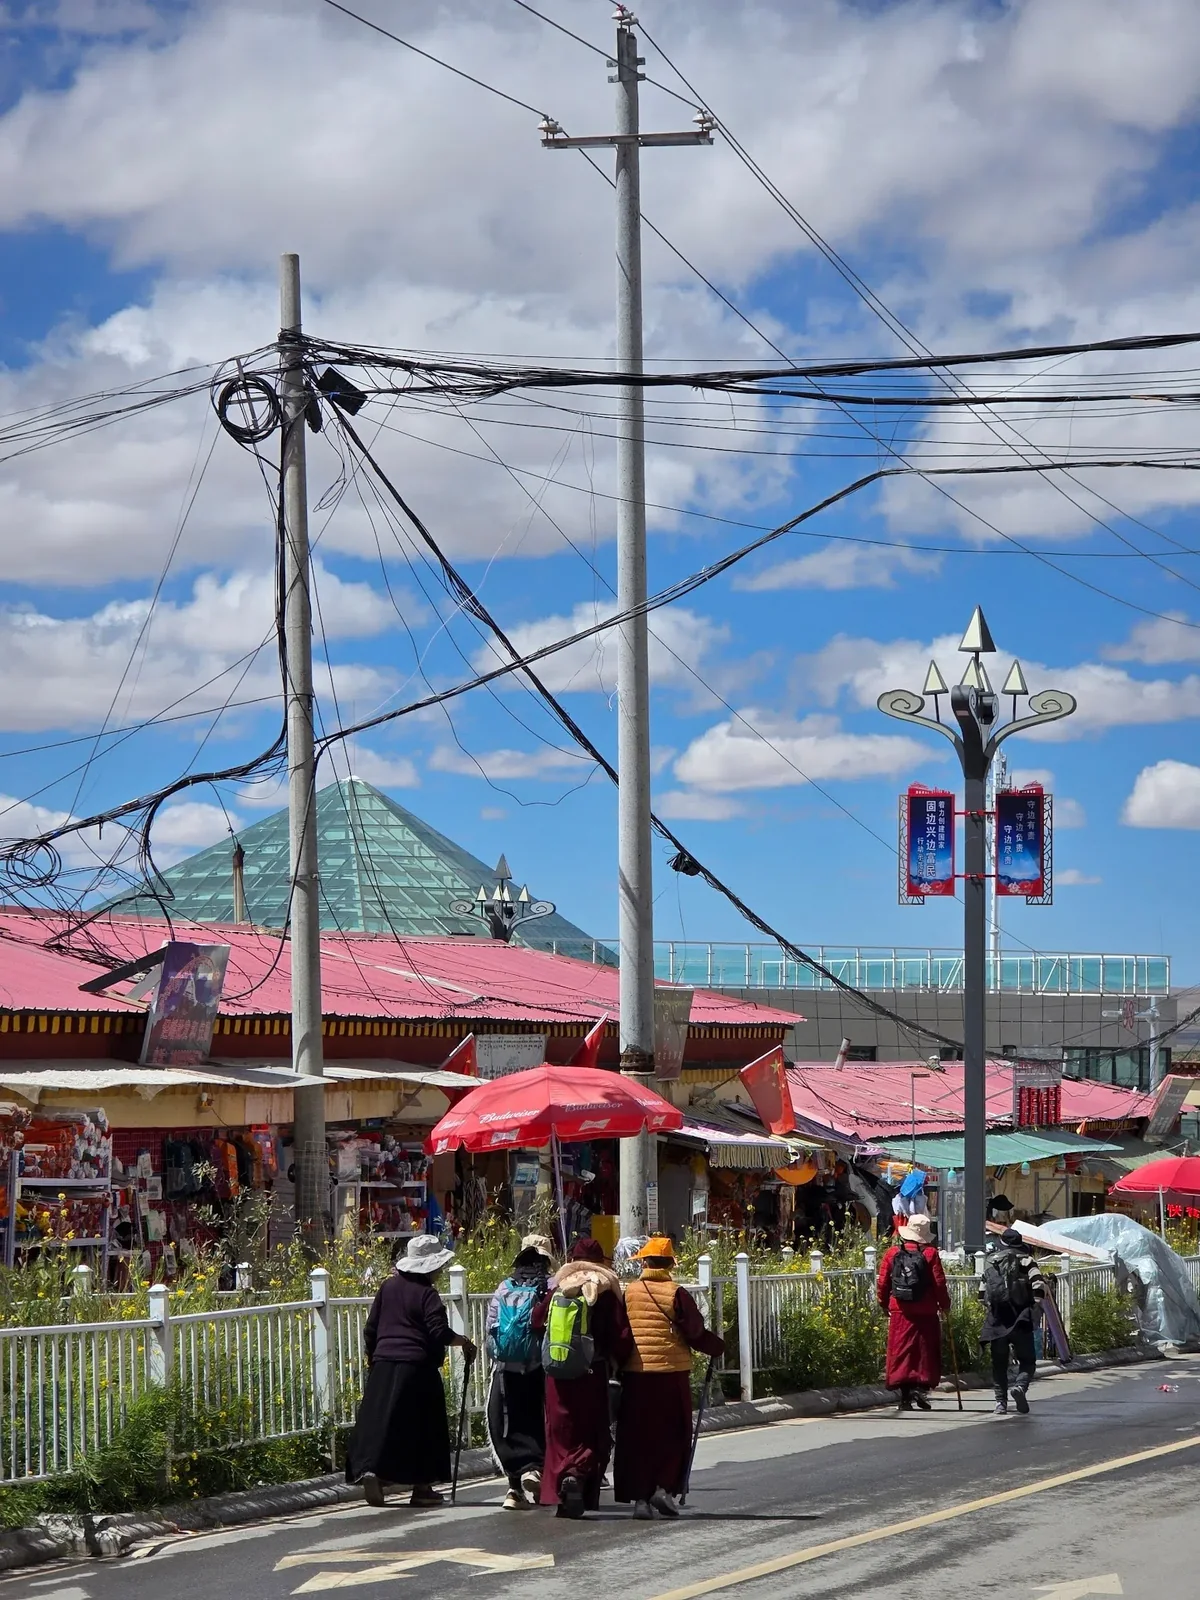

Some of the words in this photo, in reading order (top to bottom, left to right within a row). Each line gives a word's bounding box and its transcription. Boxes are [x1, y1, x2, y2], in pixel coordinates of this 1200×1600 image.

[926, 800, 937, 877] 固边兴边富民
[1015, 812, 1024, 853] 守边负责
[1027, 800, 1036, 841] 守边有责
[1003, 825, 1013, 865] 守边尽责
[479, 1109, 540, 1125] Budweiser
[560, 1102, 624, 1113] Budweiser
